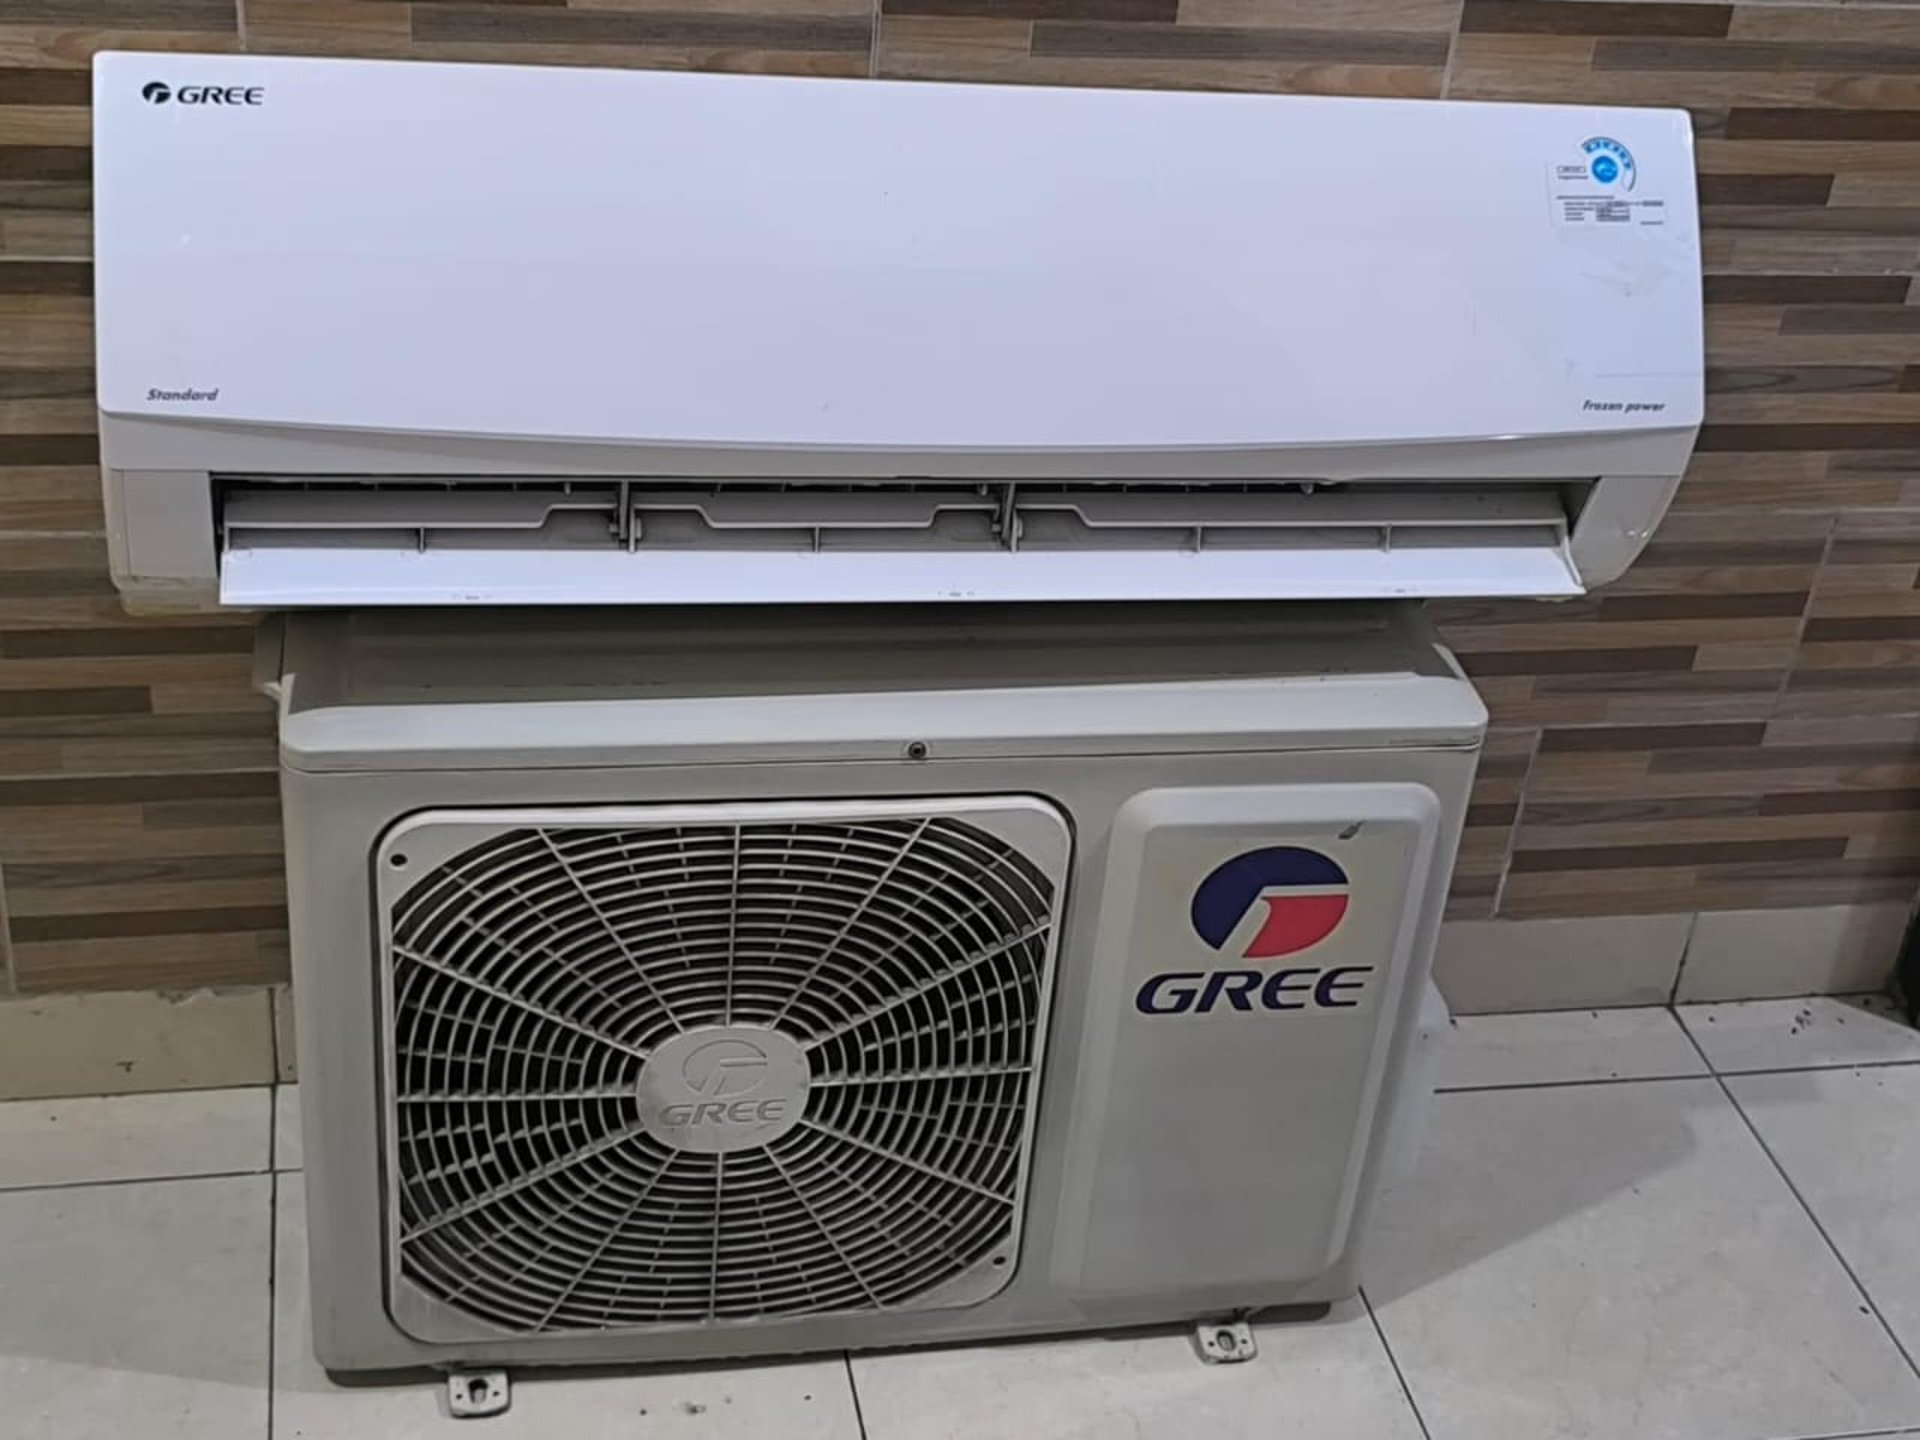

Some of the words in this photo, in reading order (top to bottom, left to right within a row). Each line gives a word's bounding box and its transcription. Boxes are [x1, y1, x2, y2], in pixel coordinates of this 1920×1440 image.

[177, 86, 264, 105] GREE
[147, 388, 218, 401] Standard
[1624, 403, 1665, 414] power
[1136, 966, 1374, 1014] GREE
[658, 1099, 787, 1127] GREE
